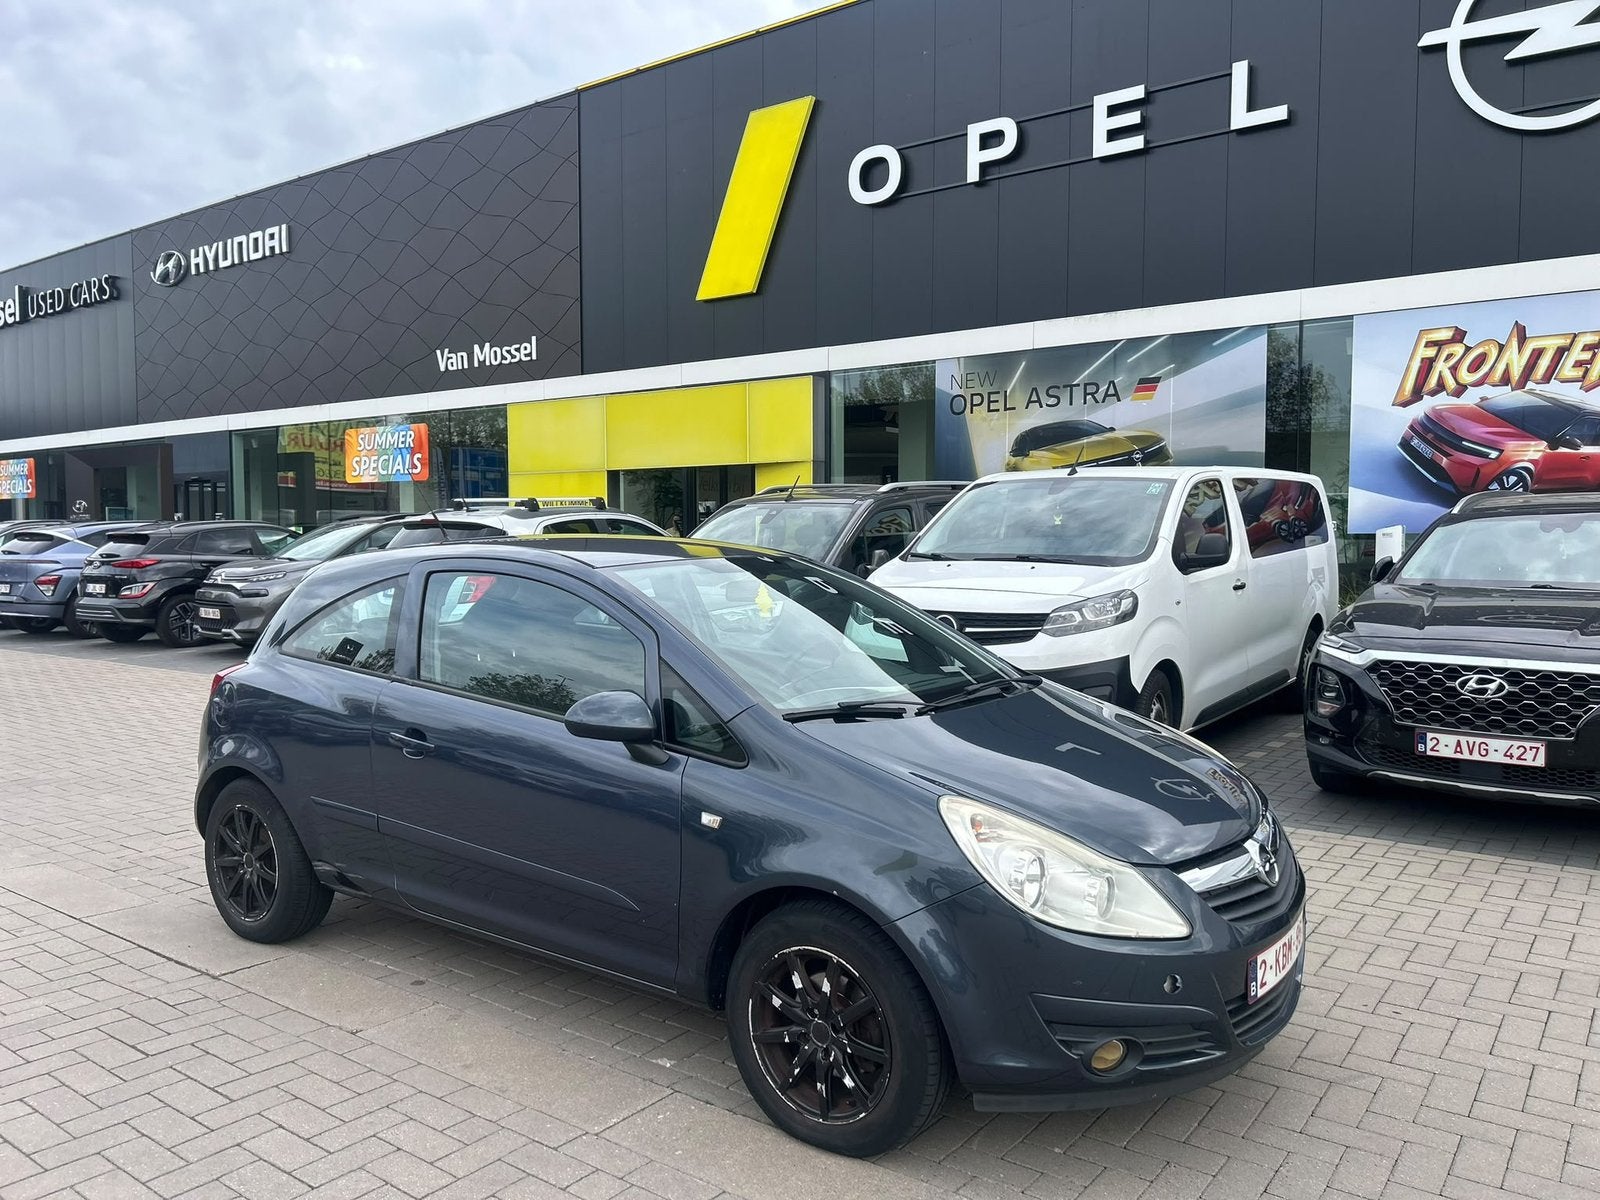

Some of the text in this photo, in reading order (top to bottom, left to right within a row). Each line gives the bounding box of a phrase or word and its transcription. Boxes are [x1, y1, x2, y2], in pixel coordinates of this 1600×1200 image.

[848, 59, 1289, 205] OPEL
[190, 224, 288, 275] HYUNDAI
[28, 287, 64, 318] USED
[70, 274, 110, 307] CARS
[436, 335, 537, 372] Van Mossel
[950, 370, 997, 392] NEW
[949, 380, 1121, 416] OPEL ASTRA
[357, 430, 415, 451] SUMMER
[0, 463, 29, 477] SUMMER
[351, 452, 423, 477] SPECIALS
[0, 479, 33, 494] PECIALS
[1429, 737, 1540, 762] 2-AVG-427
